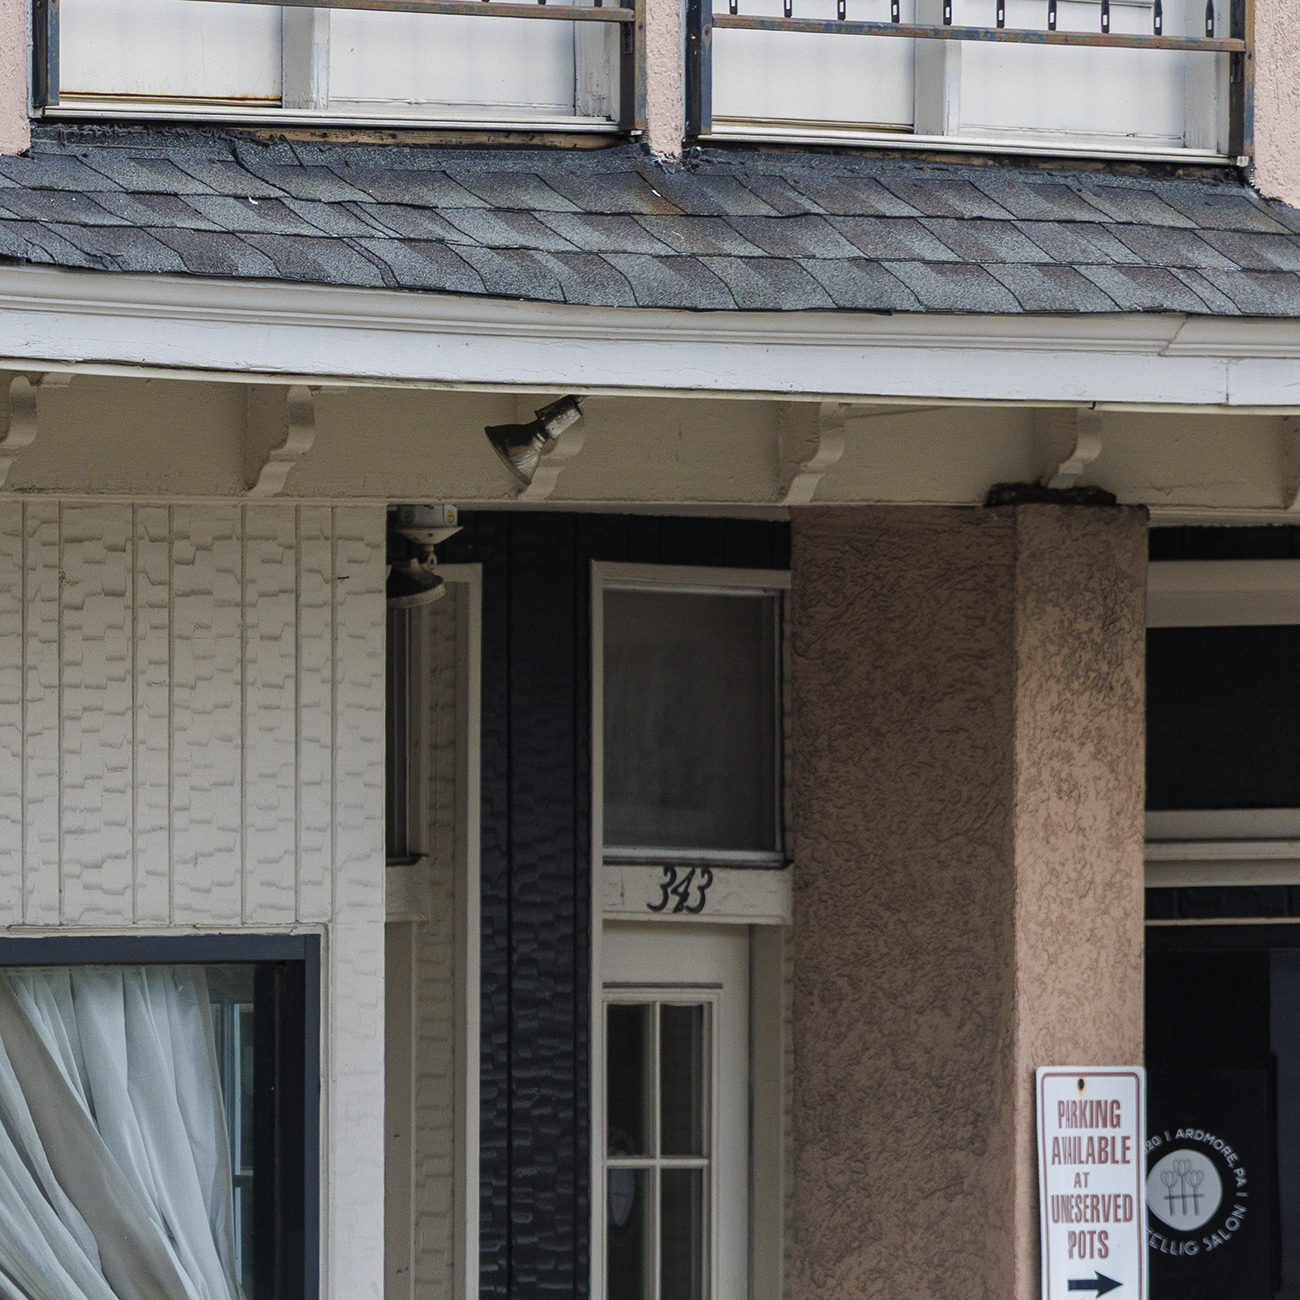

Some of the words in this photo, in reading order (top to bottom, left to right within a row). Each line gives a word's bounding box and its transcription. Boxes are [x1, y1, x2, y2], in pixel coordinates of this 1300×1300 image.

[646, 865, 713, 914] 343
[1057, 1100, 1121, 1129] PARKING
[1051, 1136, 1131, 1165] AVAILABLE
[1175, 1128, 1239, 1168] ARDMORE,
[1233, 1167, 1248, 1187] PA
[1073, 1172, 1090, 1188] AT
[1146, 1226, 1200, 1256] ELLIG
[1203, 1203, 1247, 1252] SALON
